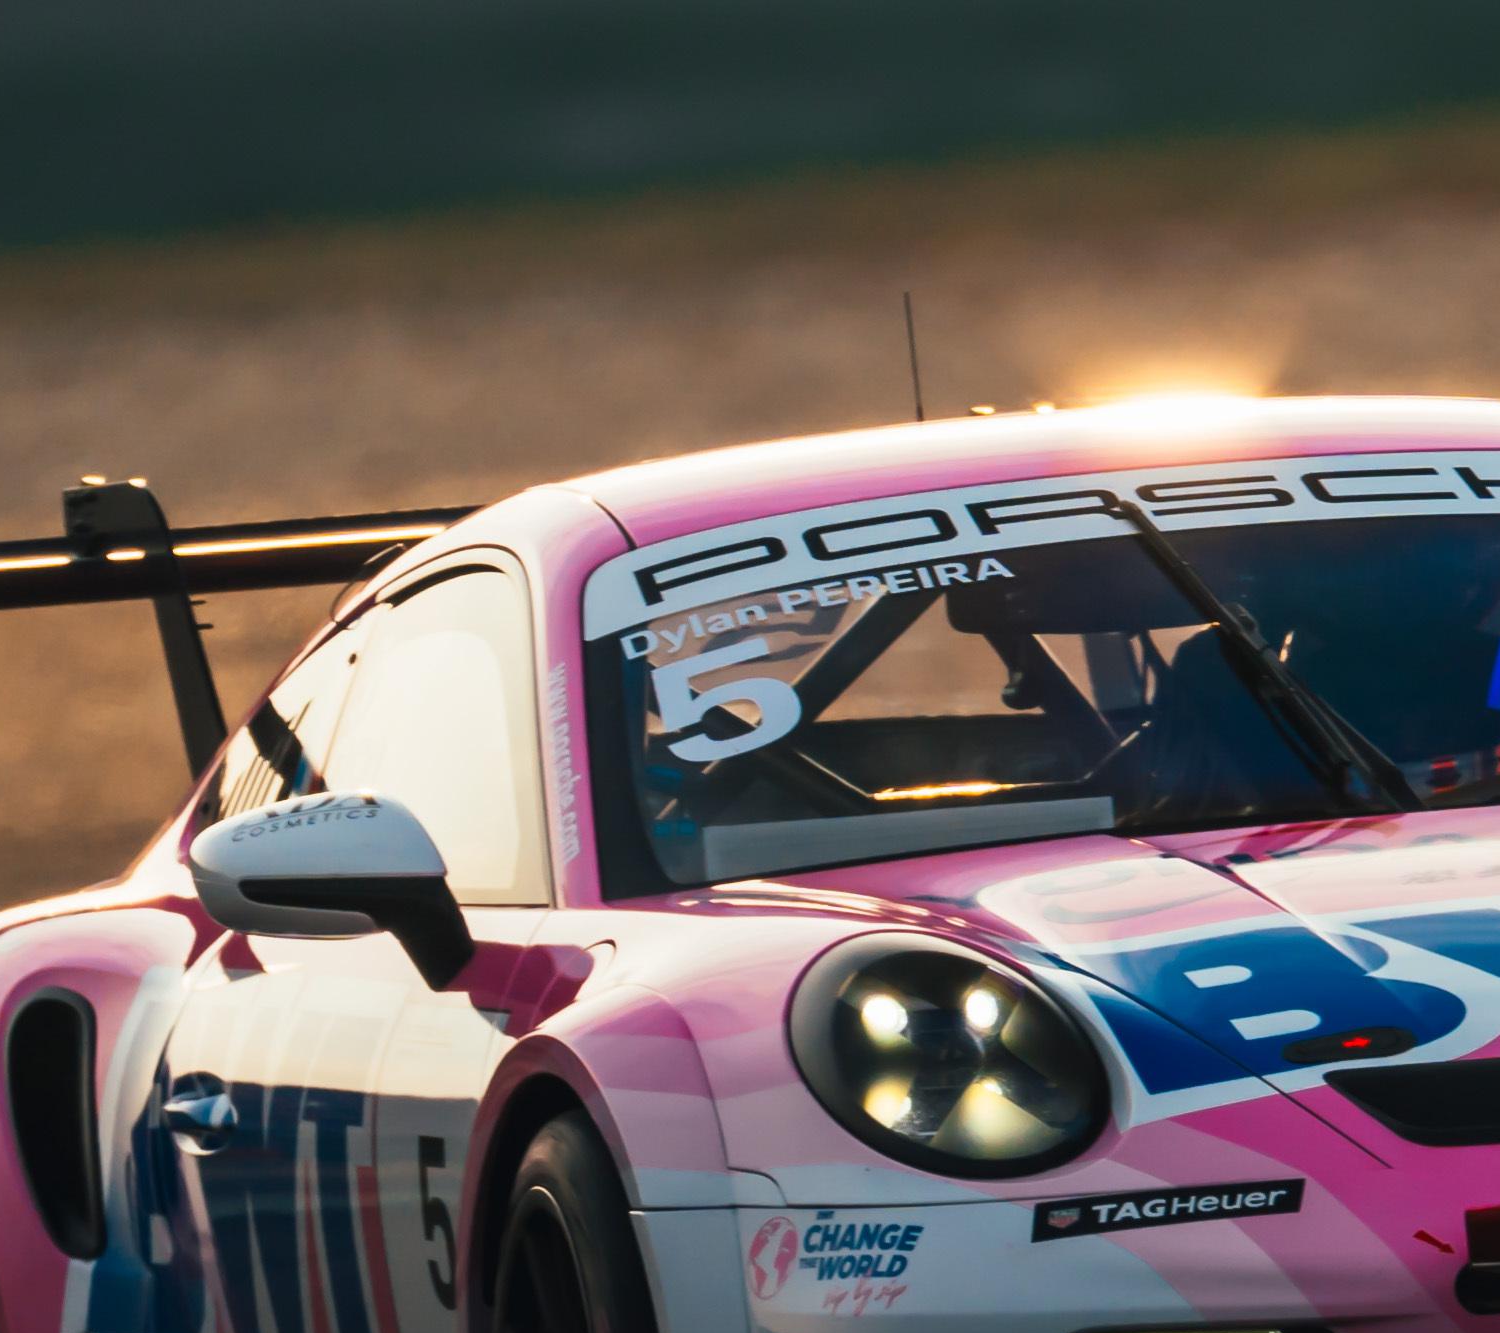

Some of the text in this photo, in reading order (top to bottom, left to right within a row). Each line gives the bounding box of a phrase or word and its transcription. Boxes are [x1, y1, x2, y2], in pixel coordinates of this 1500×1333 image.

[619, 557, 1015, 661] Dylan PEREIRA
[651, 637, 802, 762] 5
[548, 662, 583, 866] www.porsche.com
[231, 807, 379, 843] COSMETICS
[417, 1135, 457, 1312] 5
[803, 1223, 925, 1253] CHANGE
[816, 1254, 908, 1281] WORLD
